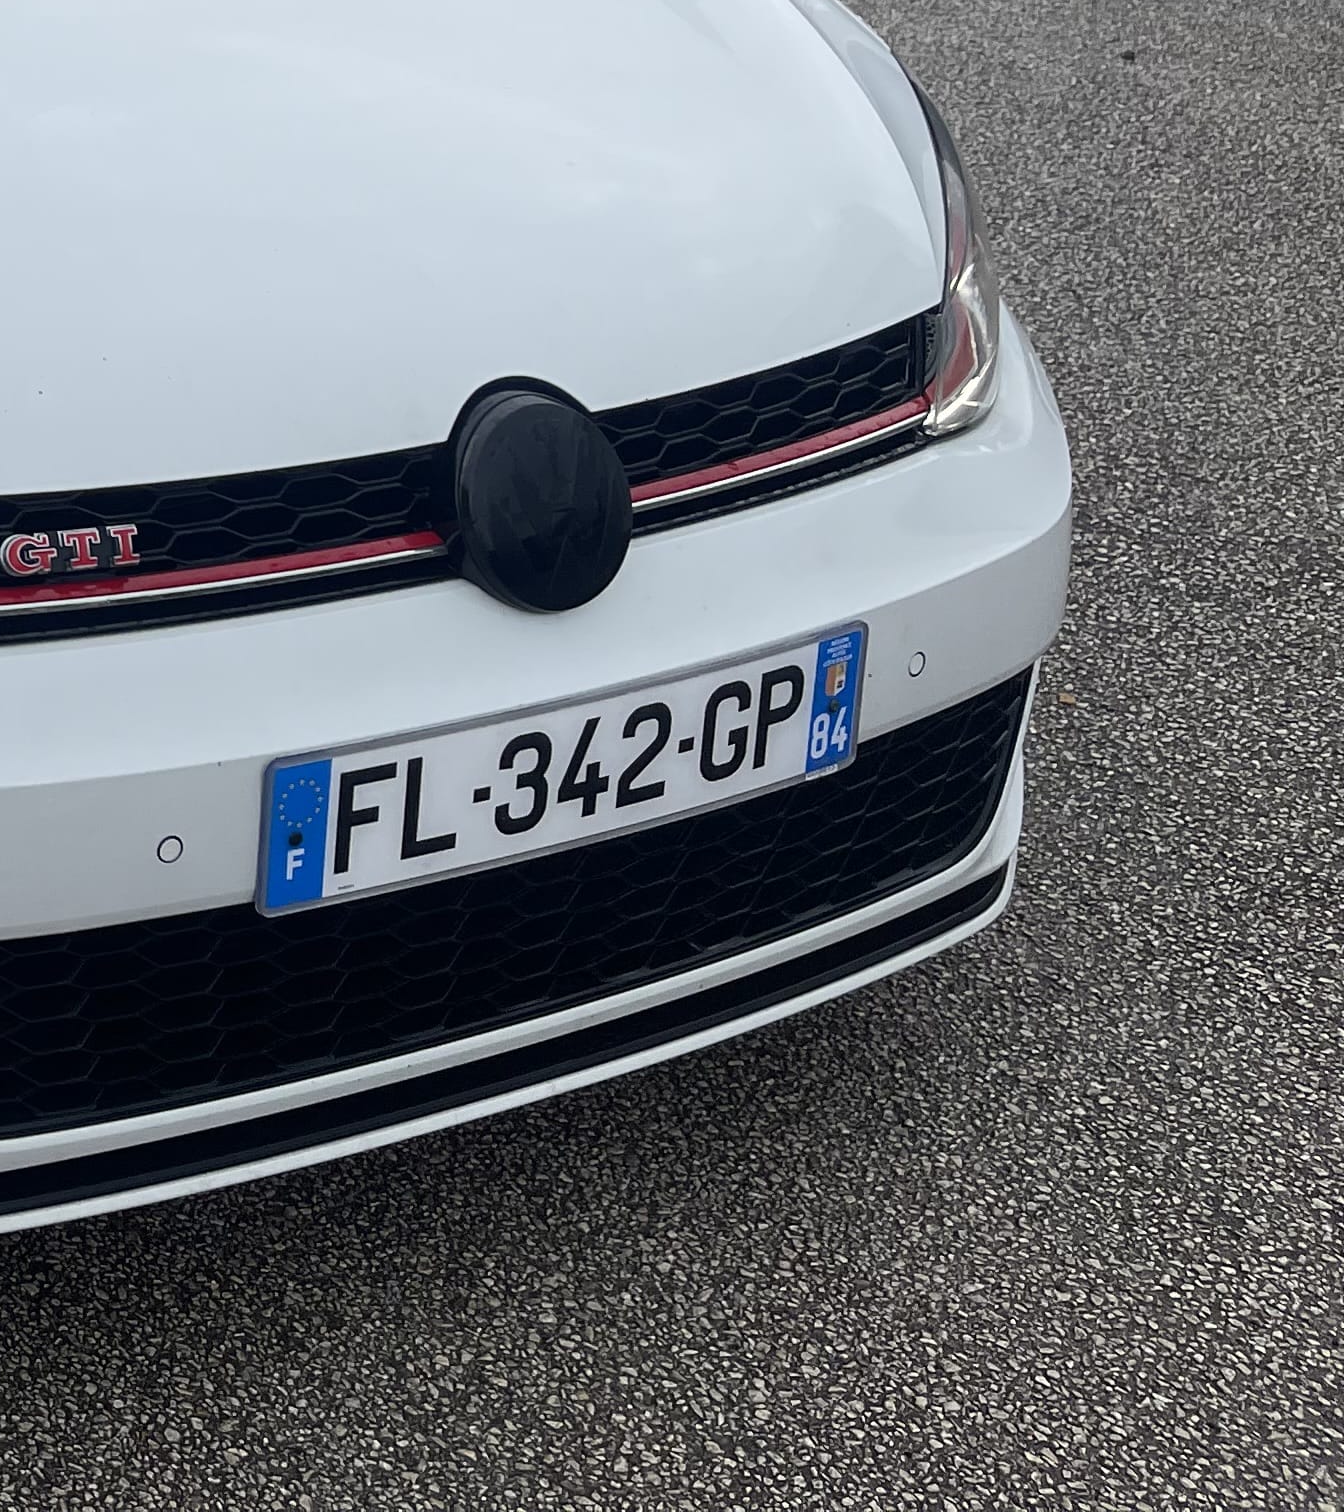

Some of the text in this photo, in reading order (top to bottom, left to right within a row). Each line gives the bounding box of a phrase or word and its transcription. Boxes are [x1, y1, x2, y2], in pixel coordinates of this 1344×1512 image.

[0, 524, 140, 577] GTI
[810, 706, 848, 759] 84
[333, 664, 805, 875] FL-342-GP
[286, 848, 305, 881] F
